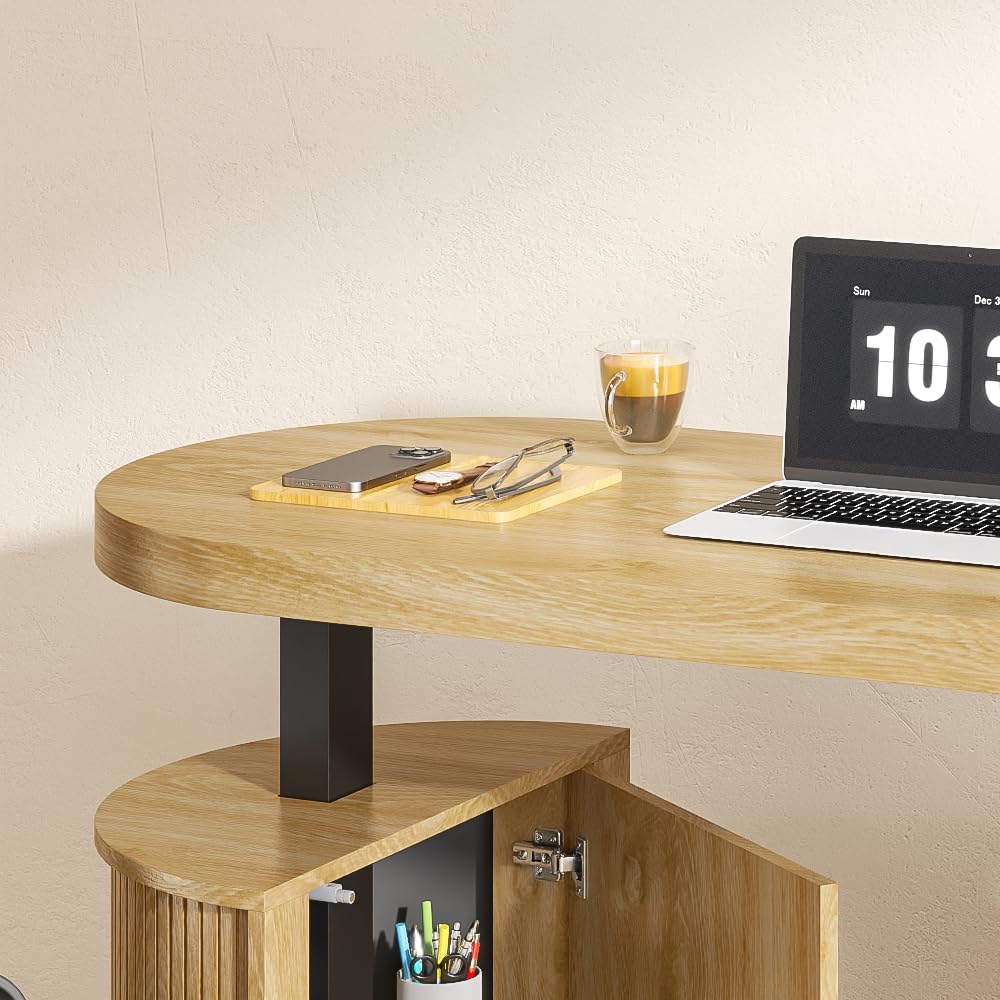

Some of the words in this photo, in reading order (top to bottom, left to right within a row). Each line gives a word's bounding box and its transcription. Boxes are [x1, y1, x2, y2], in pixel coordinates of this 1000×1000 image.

[853, 286, 871, 297] Sun
[974, 295, 992, 305] Dec
[866, 325, 949, 402] 10
[850, 400, 866, 411] AM
